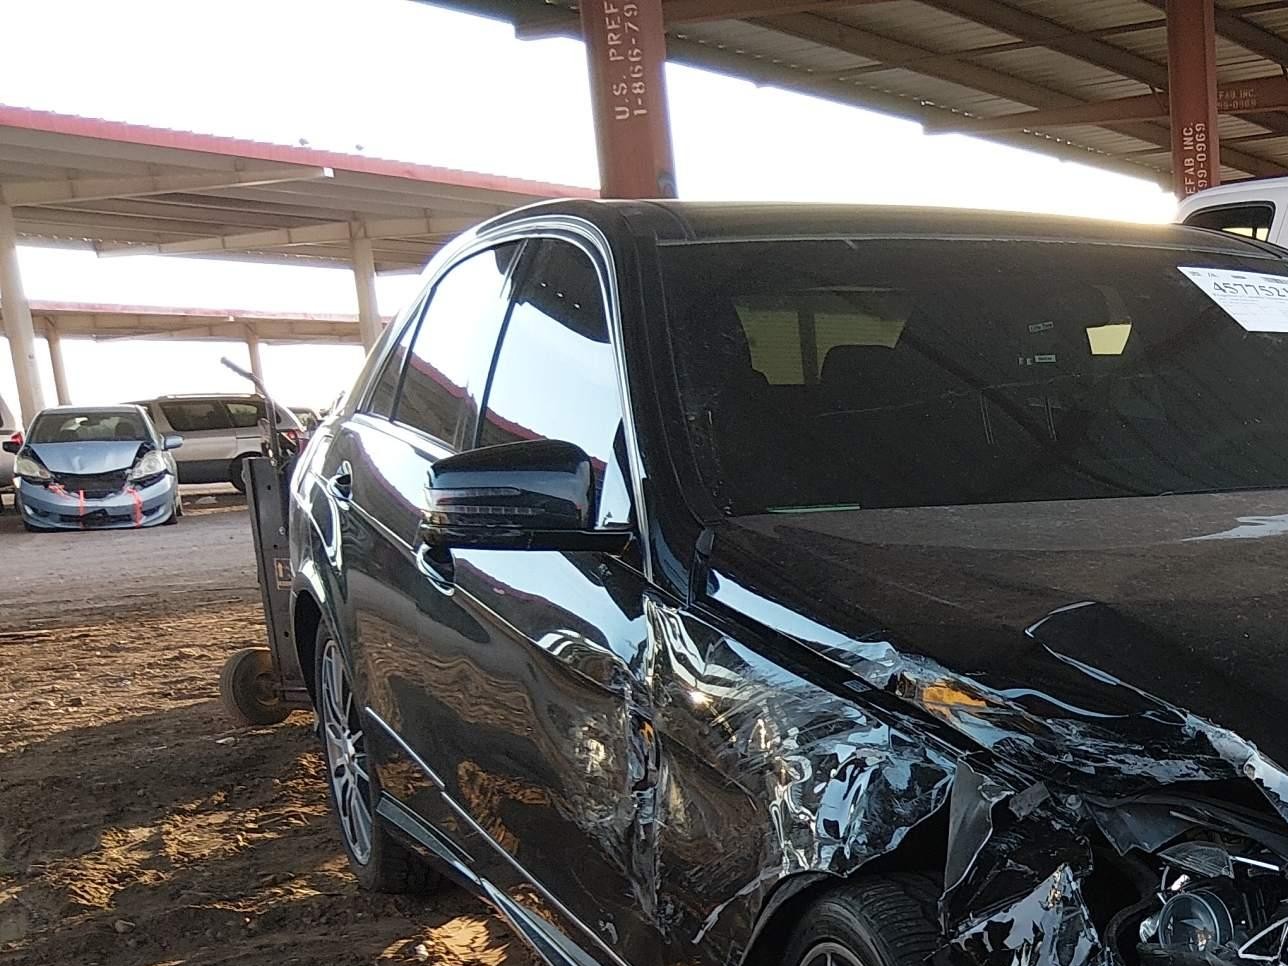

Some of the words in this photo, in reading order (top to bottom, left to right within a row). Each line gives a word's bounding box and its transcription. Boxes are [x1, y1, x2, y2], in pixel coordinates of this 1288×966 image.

[604, 1, 625, 60] PREF
[624, 4, 648, 116] 1-866-79
[612, 74, 630, 120] U.S.
[1183, 122, 1194, 150] INC.
